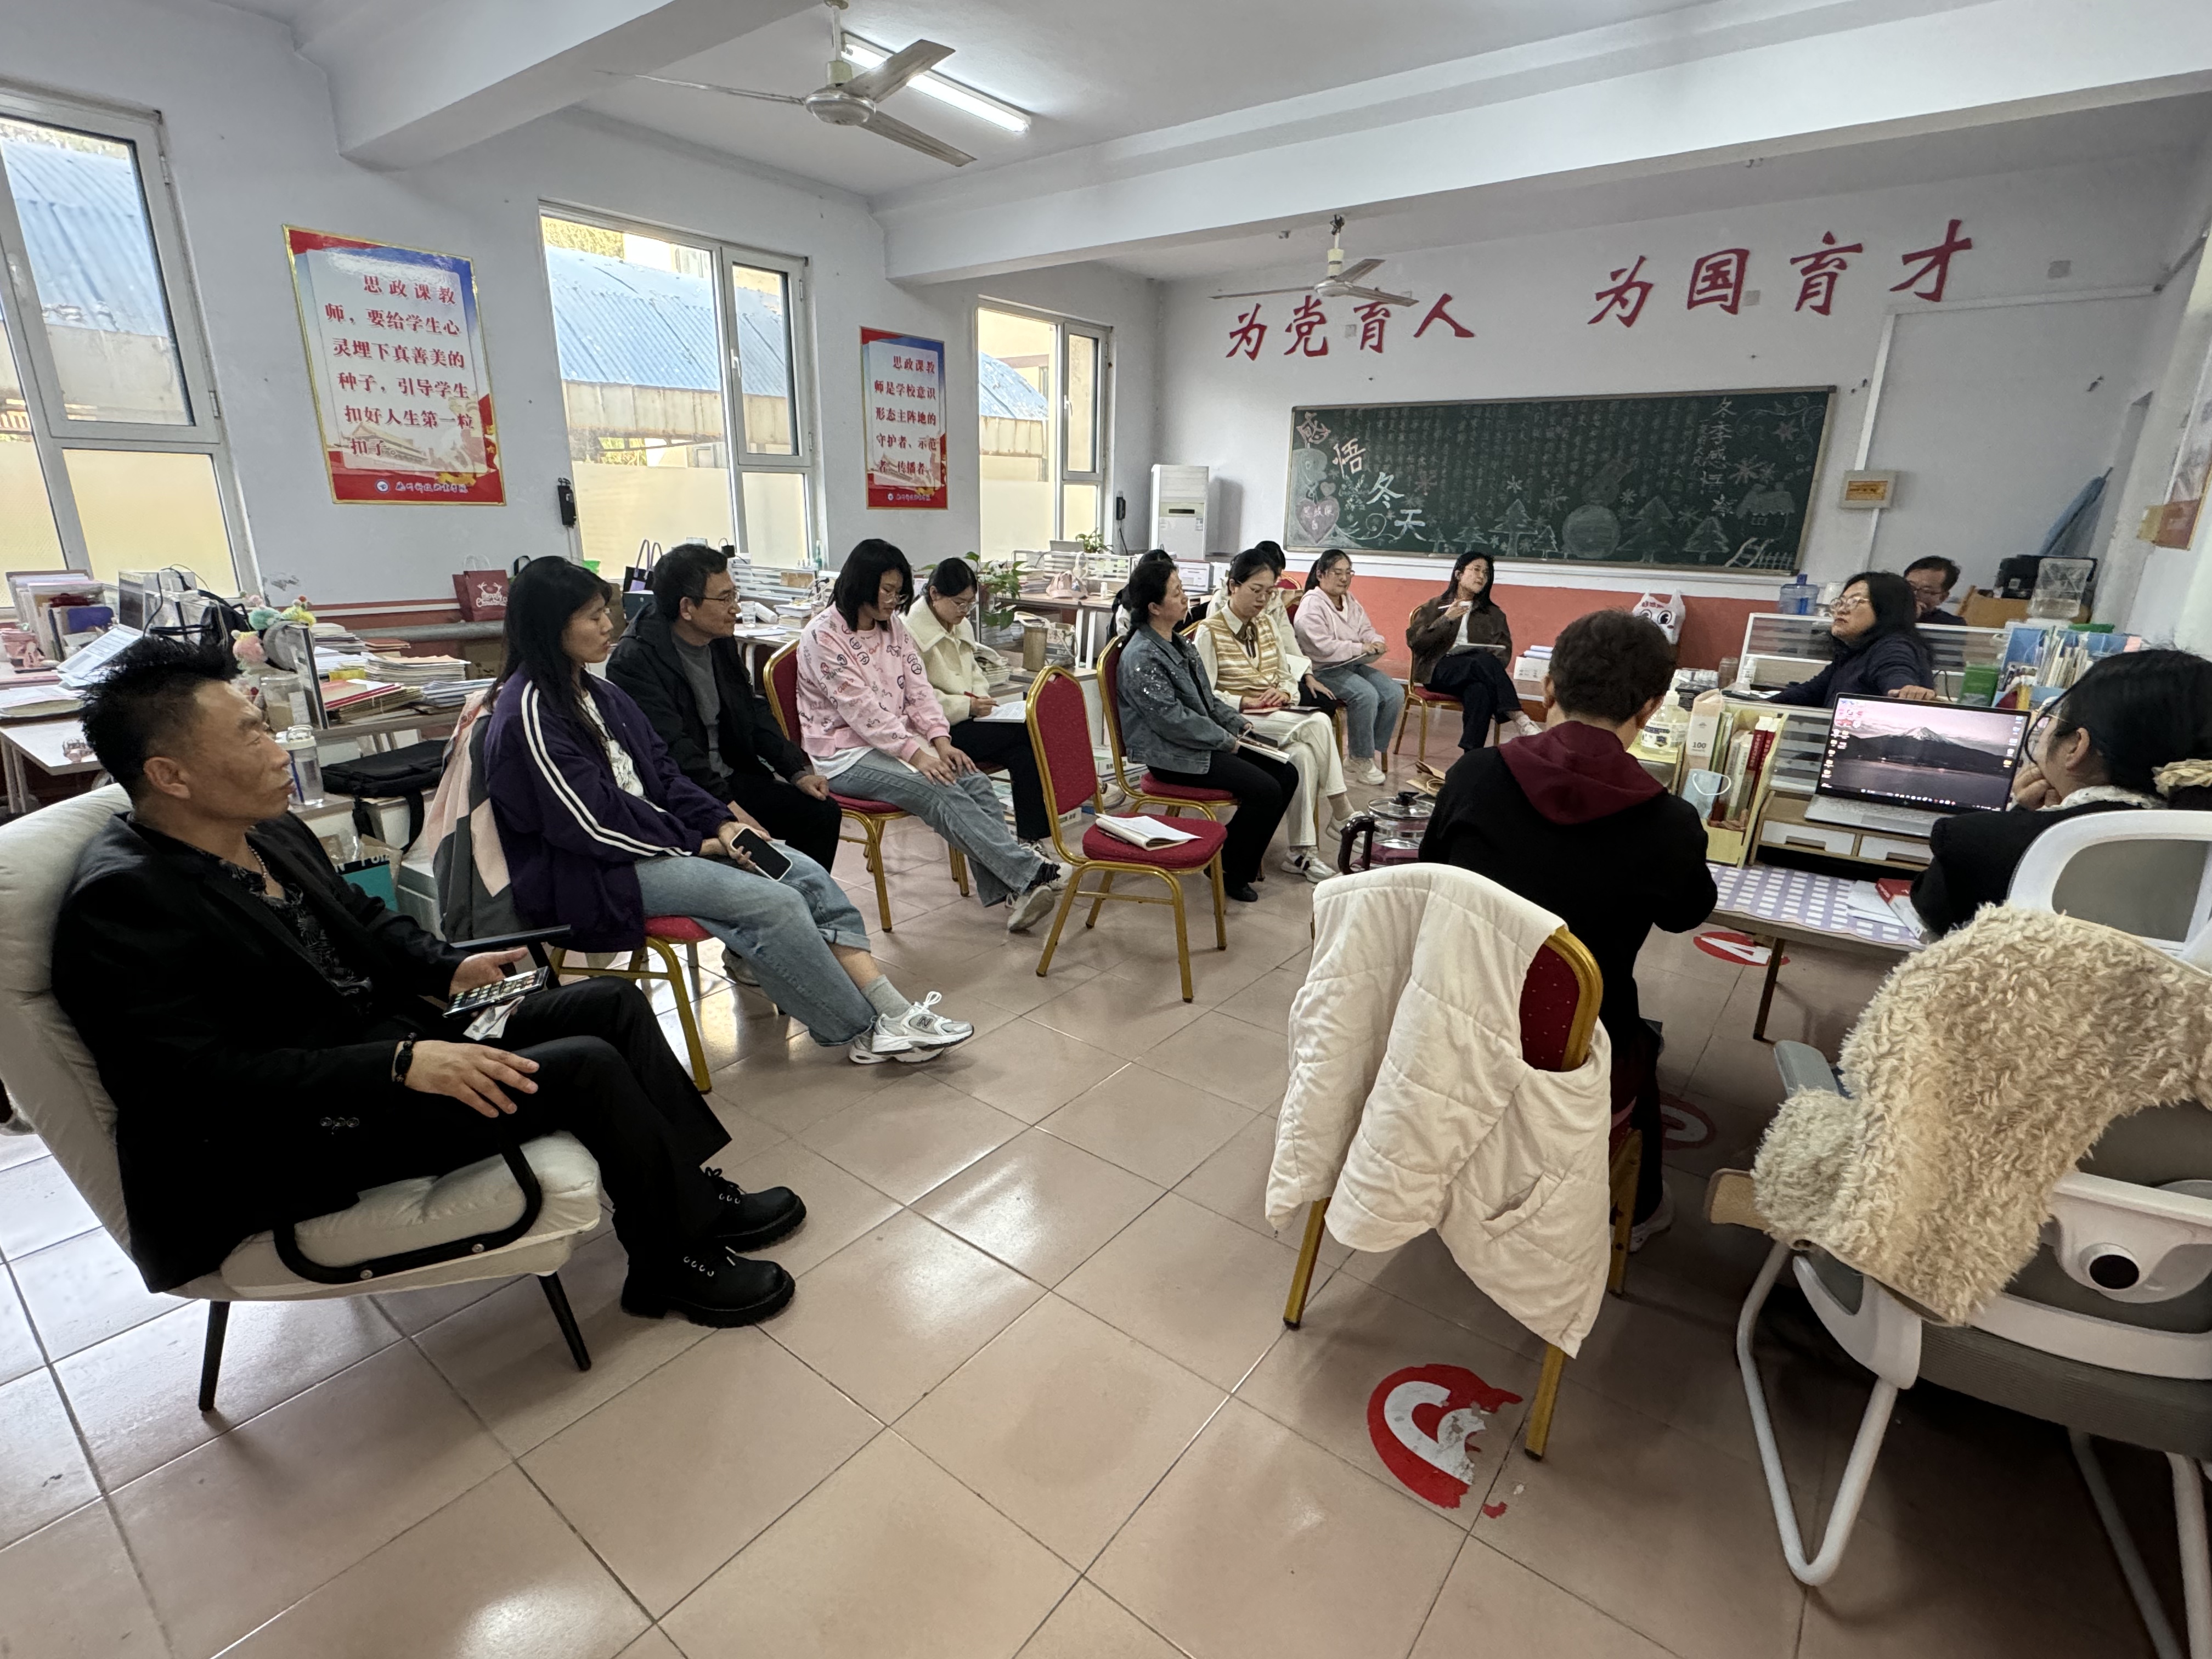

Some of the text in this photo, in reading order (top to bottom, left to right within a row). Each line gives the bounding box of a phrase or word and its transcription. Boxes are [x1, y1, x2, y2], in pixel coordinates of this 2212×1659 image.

[1588, 219, 1973, 328] 为国育才
[364, 275, 457, 305] 思政课教
[325, 303, 461, 335] 师，要给学生心
[1226, 293, 1475, 361] 为党育人
[332, 337, 465, 369] 灵埋下真善美的
[893, 355, 935, 375] 思政课教
[337, 371, 470, 399] 种子，引导学生
[874, 379, 936, 400] 师是学校意识
[344, 405, 475, 430] 扣好人生第一粒
[875, 406, 936, 426] 形态主阵地的
[876, 432, 938, 452] 守护者、示范
